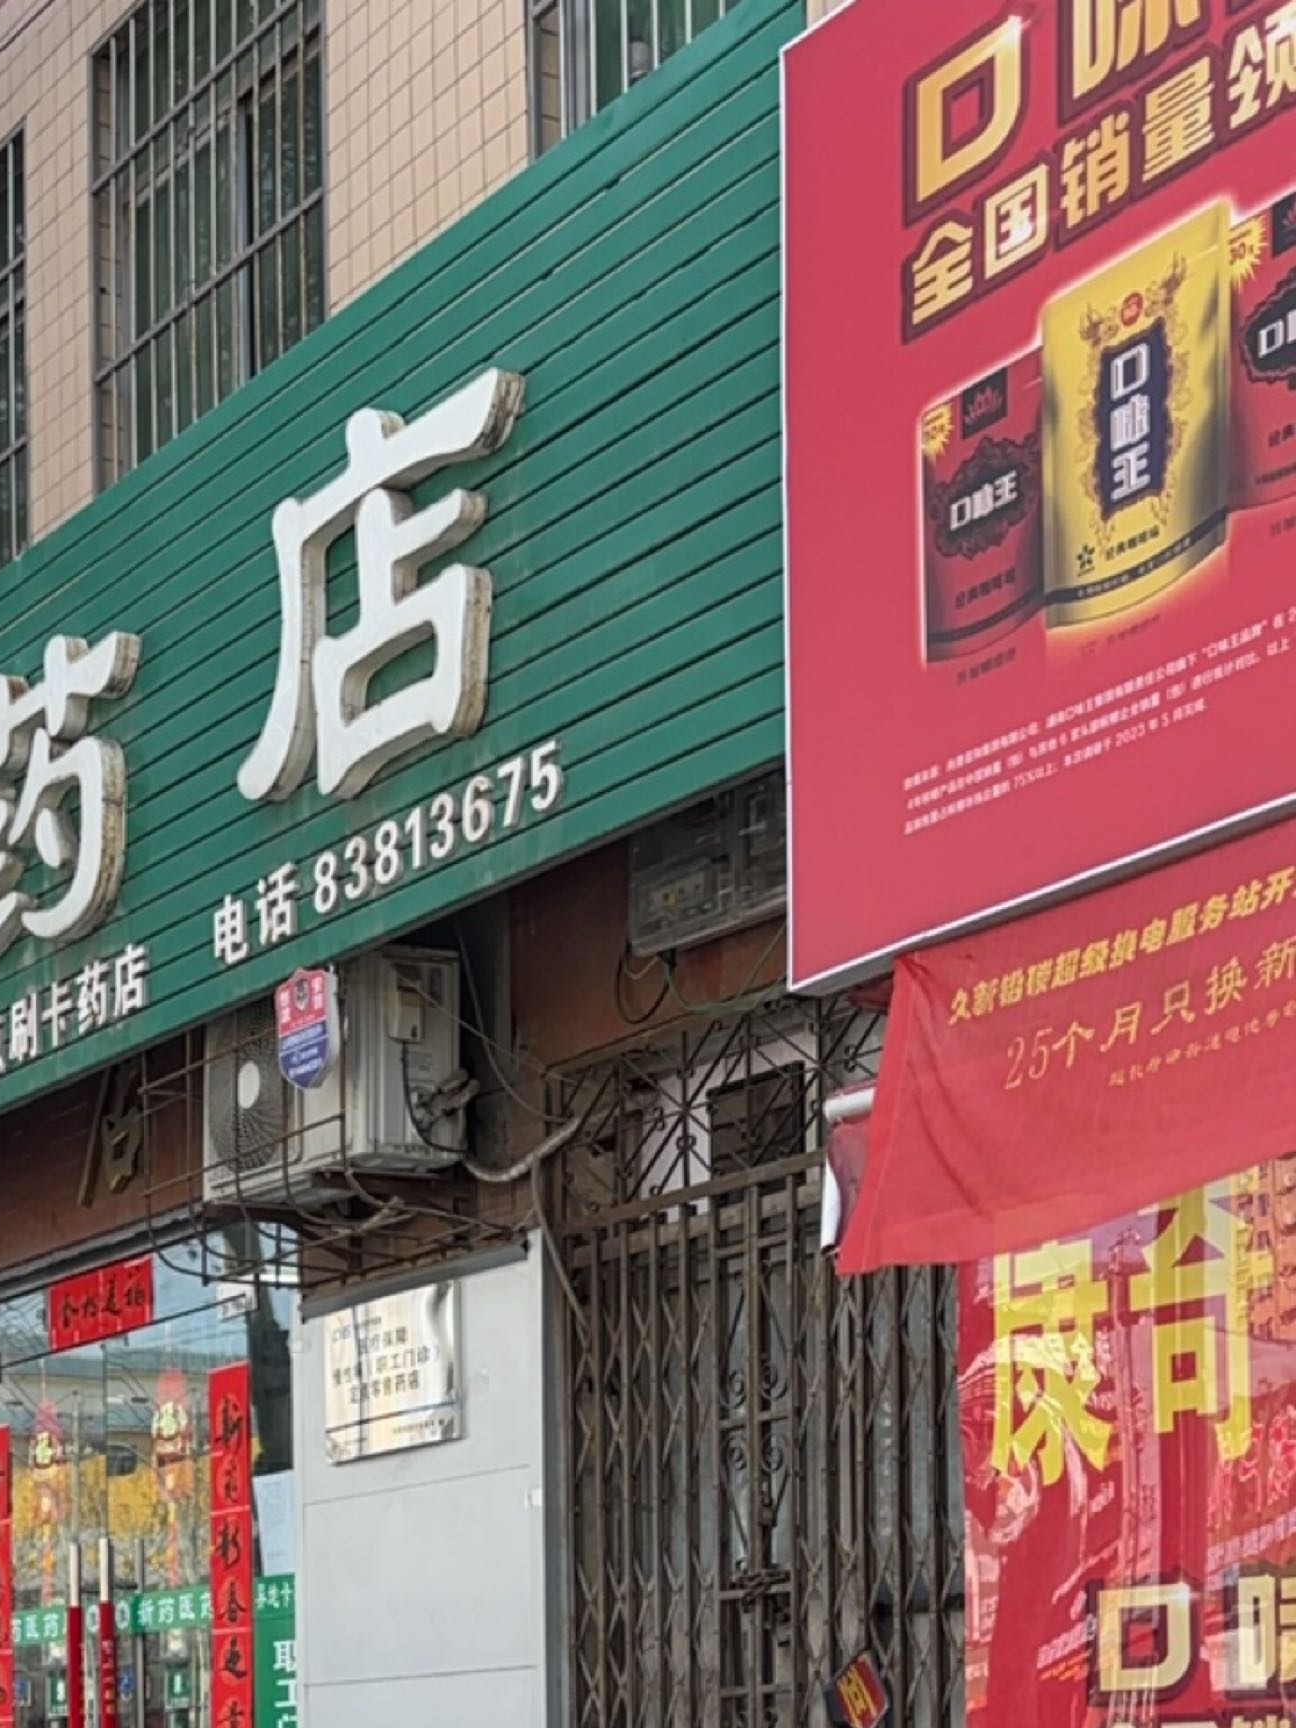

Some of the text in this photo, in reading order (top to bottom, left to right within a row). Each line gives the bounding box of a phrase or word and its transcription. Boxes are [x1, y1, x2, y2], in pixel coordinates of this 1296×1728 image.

[912, 2, 1296, 326] 全国销量领
[213, 738, 564, 965] 电话 83813675
